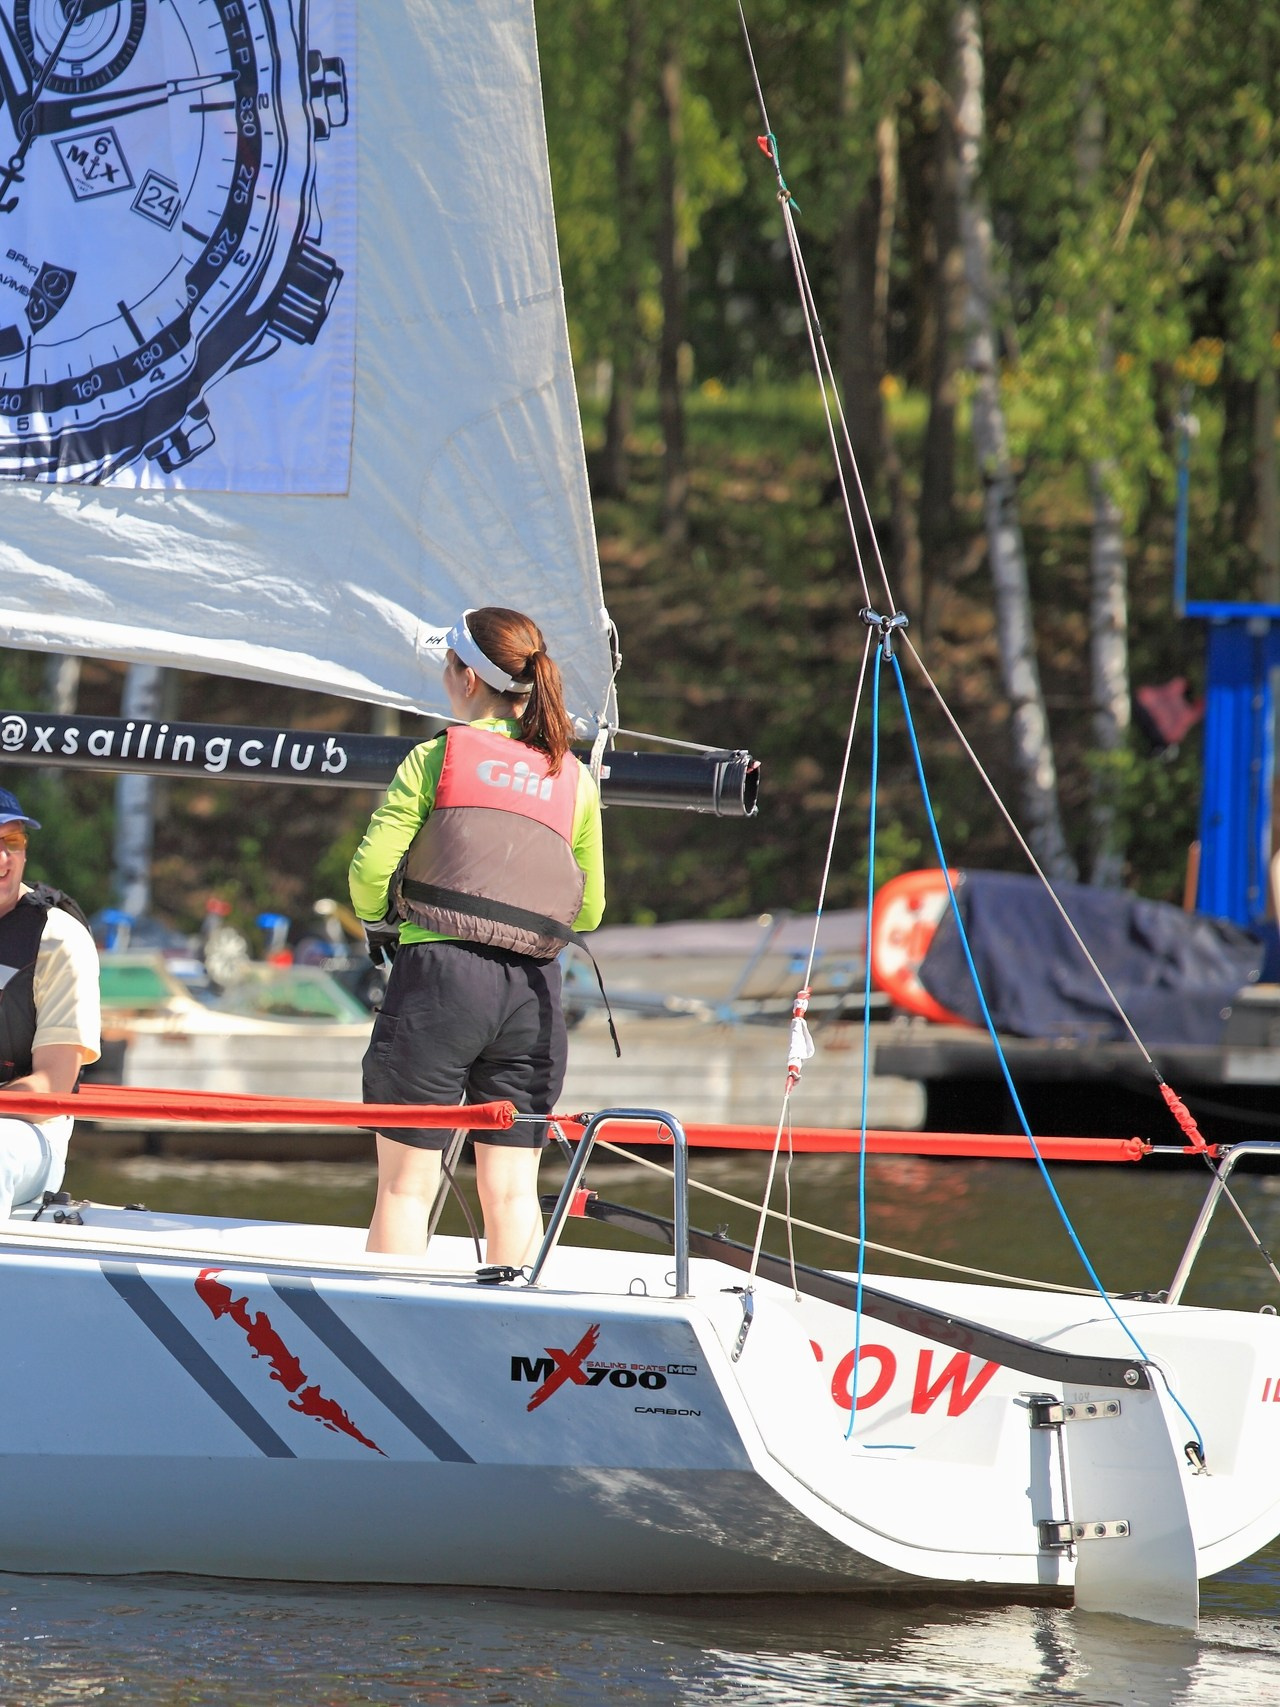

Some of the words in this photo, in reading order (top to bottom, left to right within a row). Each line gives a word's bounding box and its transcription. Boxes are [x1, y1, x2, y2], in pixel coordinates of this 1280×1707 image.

[240, 96, 257, 137] 330
[141, 185, 176, 216] 24
[234, 163, 255, 206] 275
[206, 228, 239, 267] 240
[132, 342, 163, 373] 180
[72, 374, 102, 400] 160
[0, 715, 349, 774] @xsailingclub
[476, 759, 554, 801] Gill
[586, 1360, 627, 1370] SAILING
[630, 1363, 667, 1372] BOATS
[634, 1406, 702, 1417] CARBON
